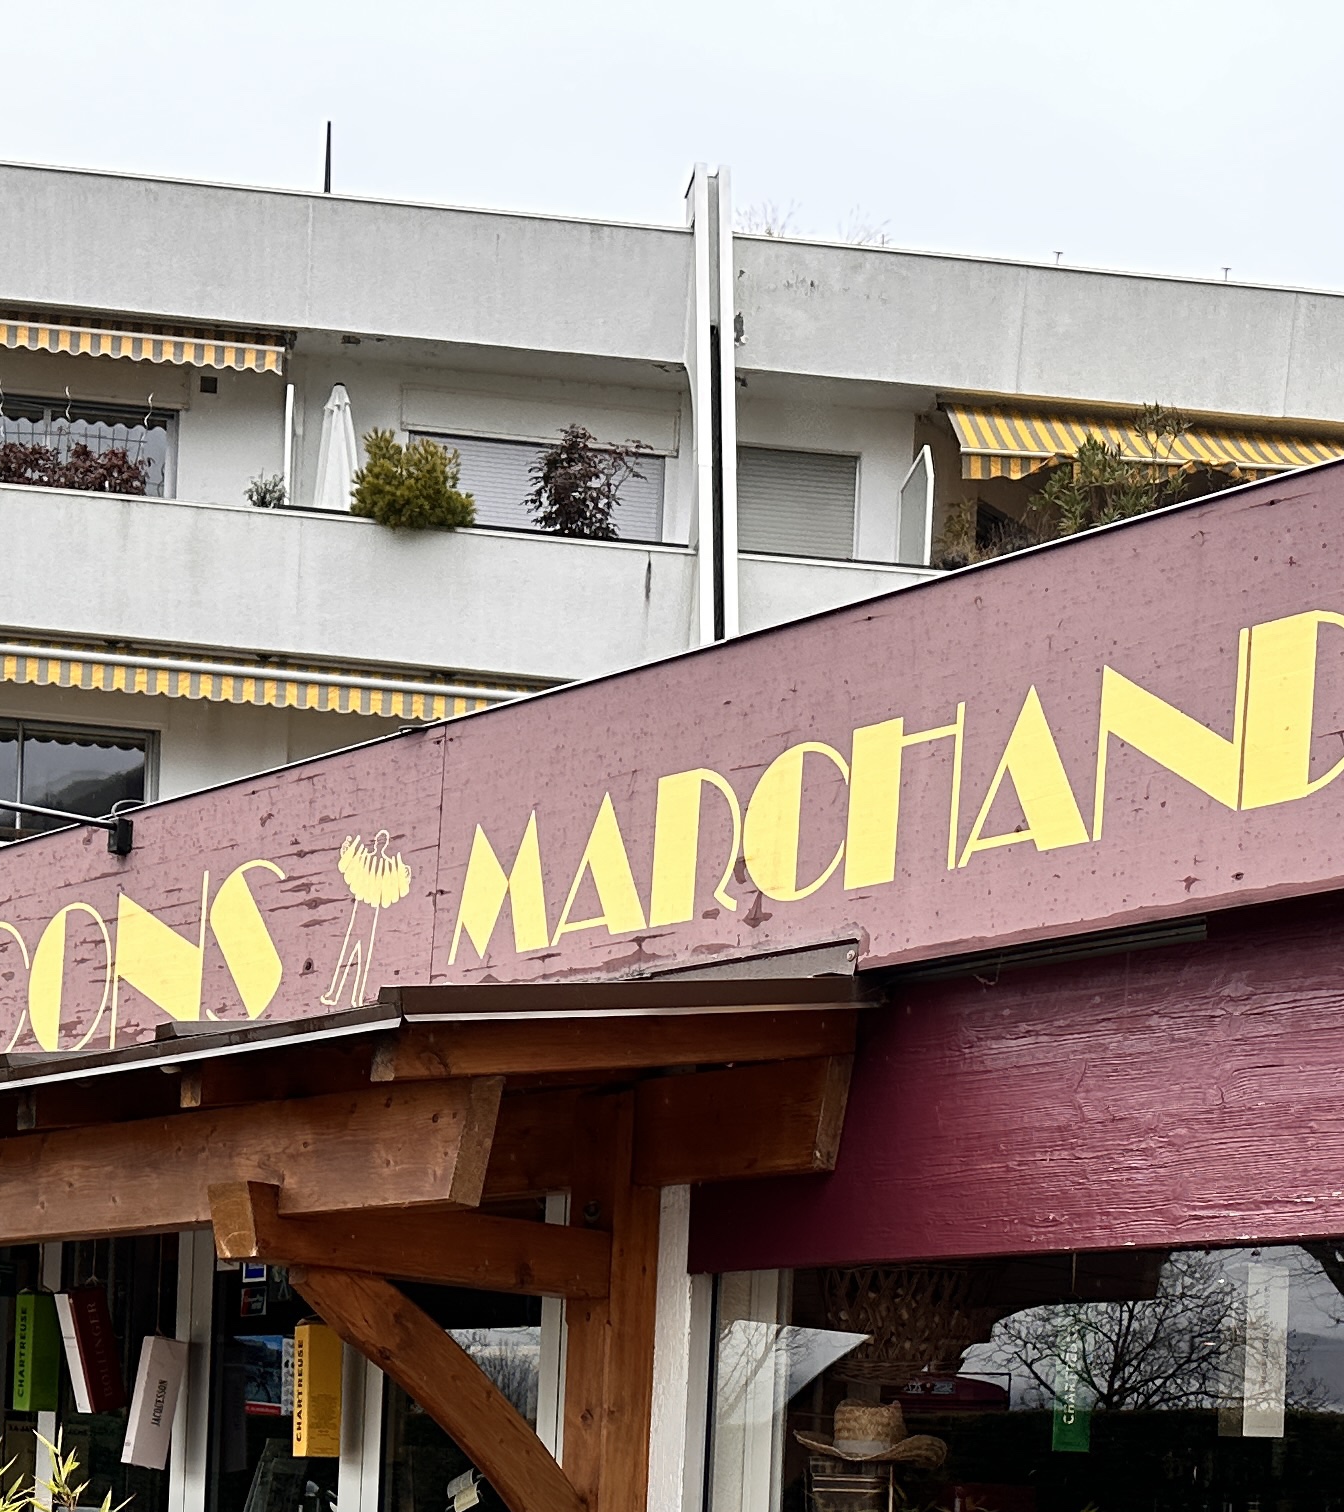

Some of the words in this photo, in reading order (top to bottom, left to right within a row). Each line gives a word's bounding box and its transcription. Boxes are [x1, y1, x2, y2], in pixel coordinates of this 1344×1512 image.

[16, 1306, 28, 1398] CHARTREUSE
[295, 1339, 304, 1442] CHARTREUSE
[150, 1378, 168, 1428] JACQUESSON
